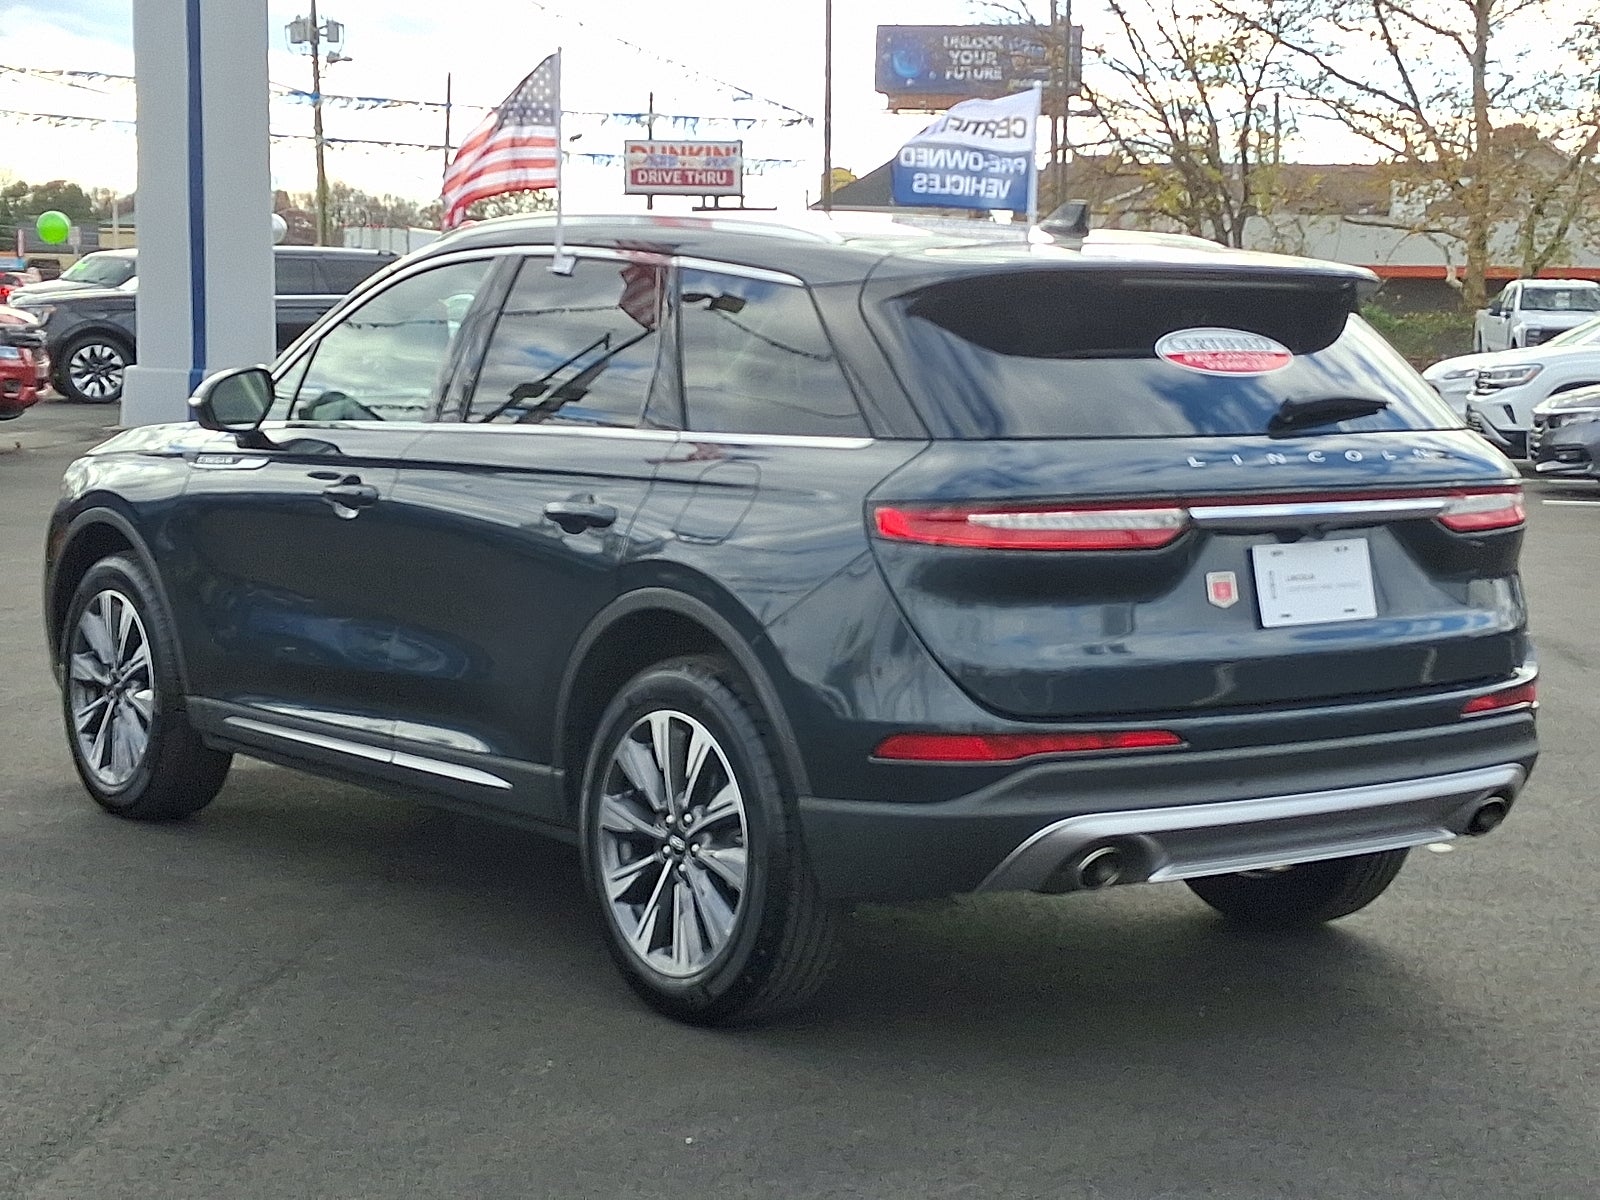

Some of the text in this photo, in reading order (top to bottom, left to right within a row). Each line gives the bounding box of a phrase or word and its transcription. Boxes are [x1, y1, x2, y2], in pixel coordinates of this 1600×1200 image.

[950, 51, 998, 66] YOUR
[945, 66, 1003, 80] FUTURE
[637, 170, 727, 184] DRIVE THRU
[1187, 448, 1431, 468] LINCOLN
